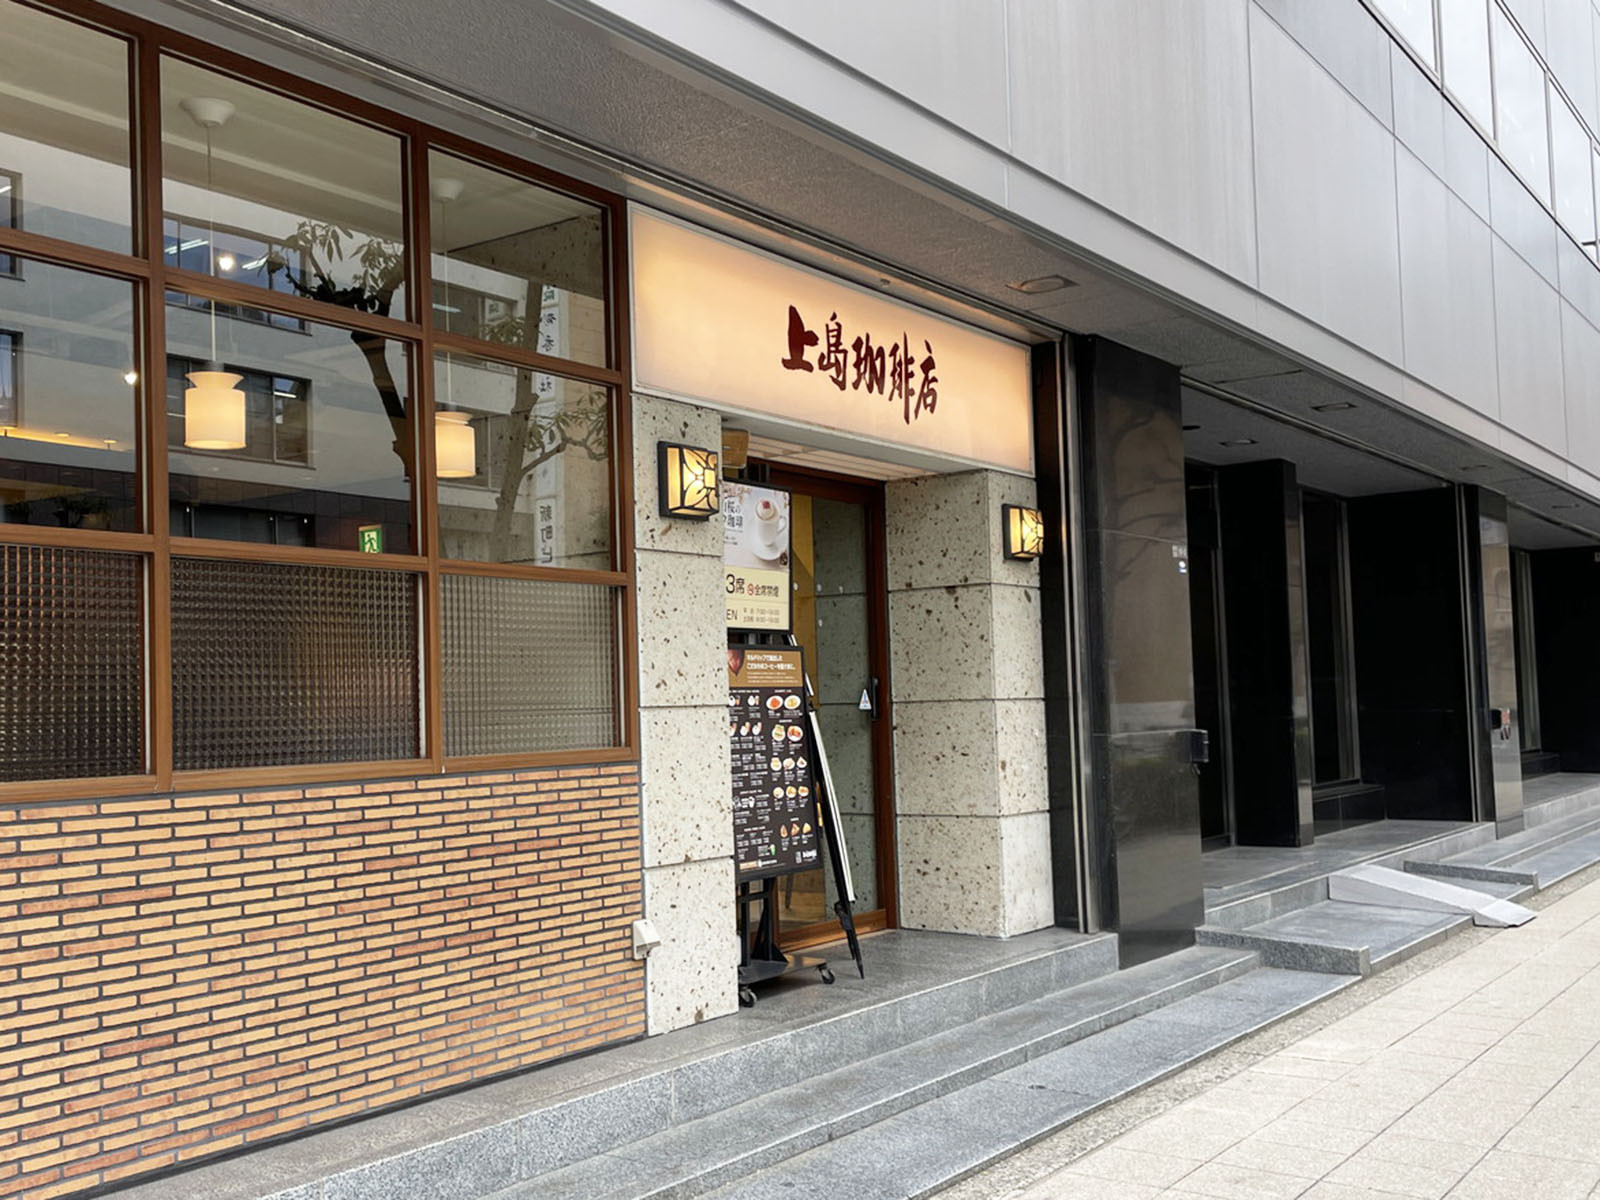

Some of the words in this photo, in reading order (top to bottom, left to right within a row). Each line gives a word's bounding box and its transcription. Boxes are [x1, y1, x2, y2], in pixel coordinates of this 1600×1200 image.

[781, 304, 939, 425] 上島珈琲店
